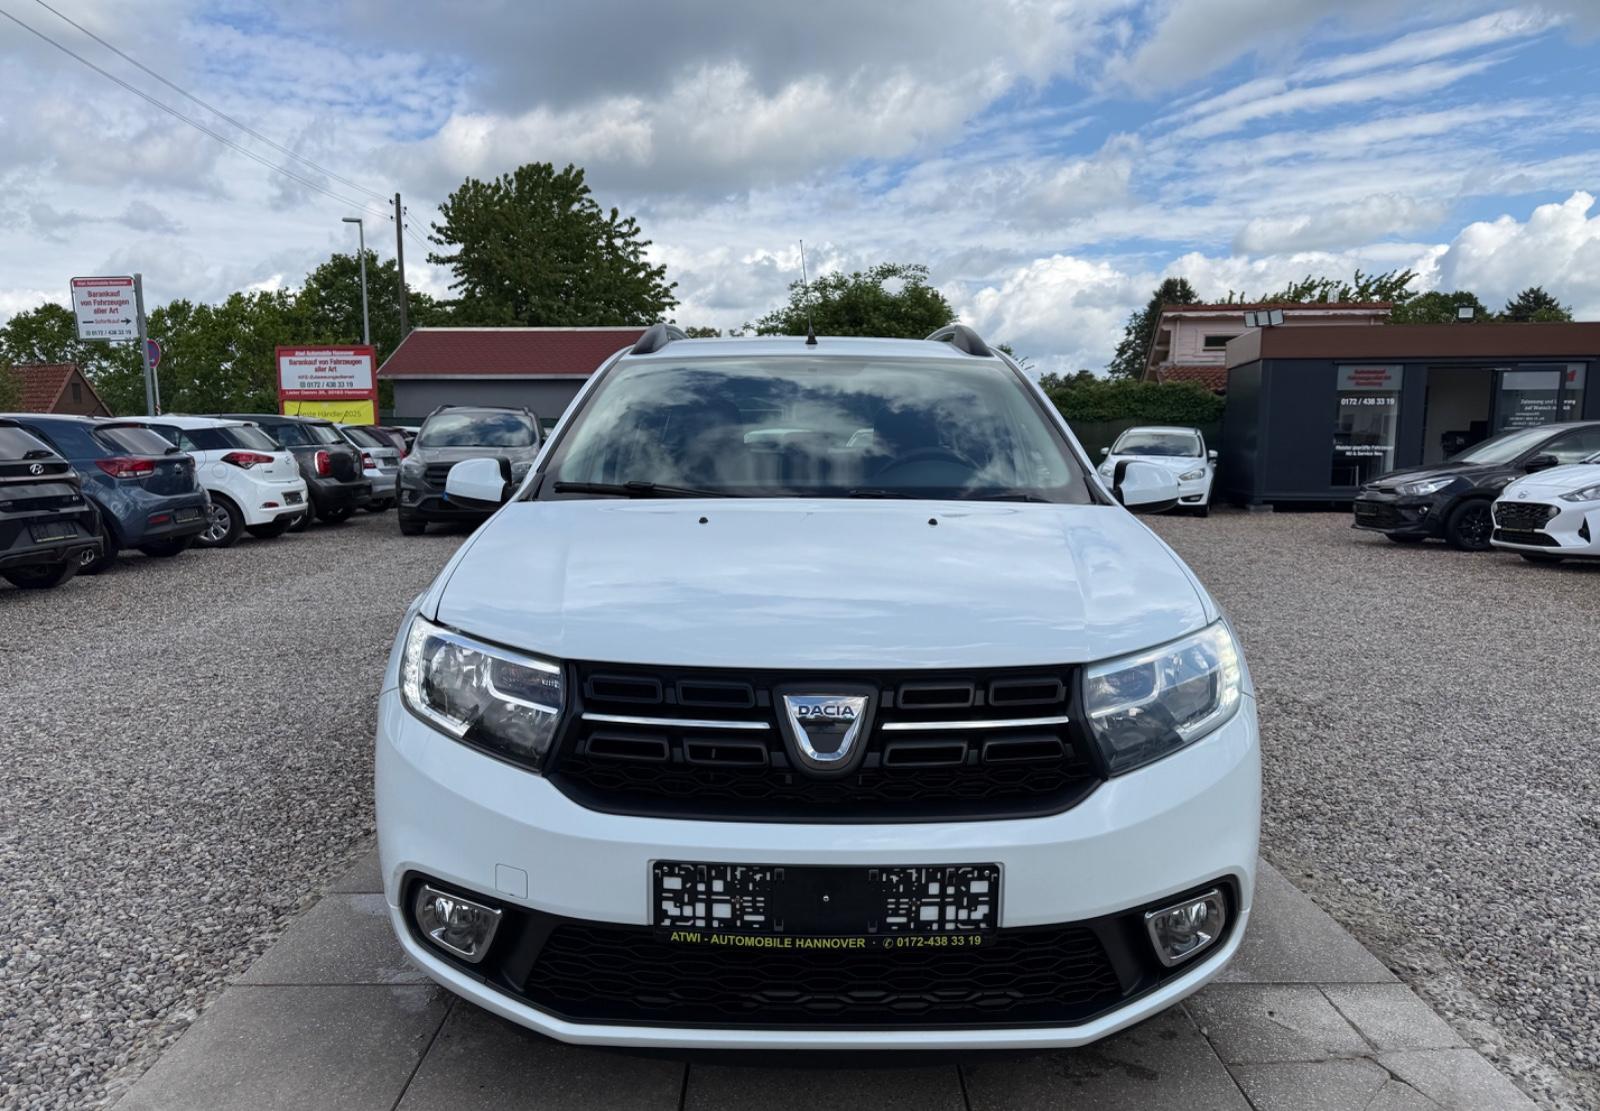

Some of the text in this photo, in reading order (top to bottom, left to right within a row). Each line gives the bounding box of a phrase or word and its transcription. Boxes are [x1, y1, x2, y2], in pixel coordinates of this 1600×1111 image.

[93, 299, 129, 307] Fahrzeugen
[798, 705, 855, 716] DACIA
[670, 931, 701, 943] ATWI
[710, 934, 792, 948] AUTOMOBILE
[796, 938, 866, 948] HANNOVER
[896, 936, 948, 947] 0172-438
[951, 936, 965, 946] 33
[969, 935, 982, 945] 19
